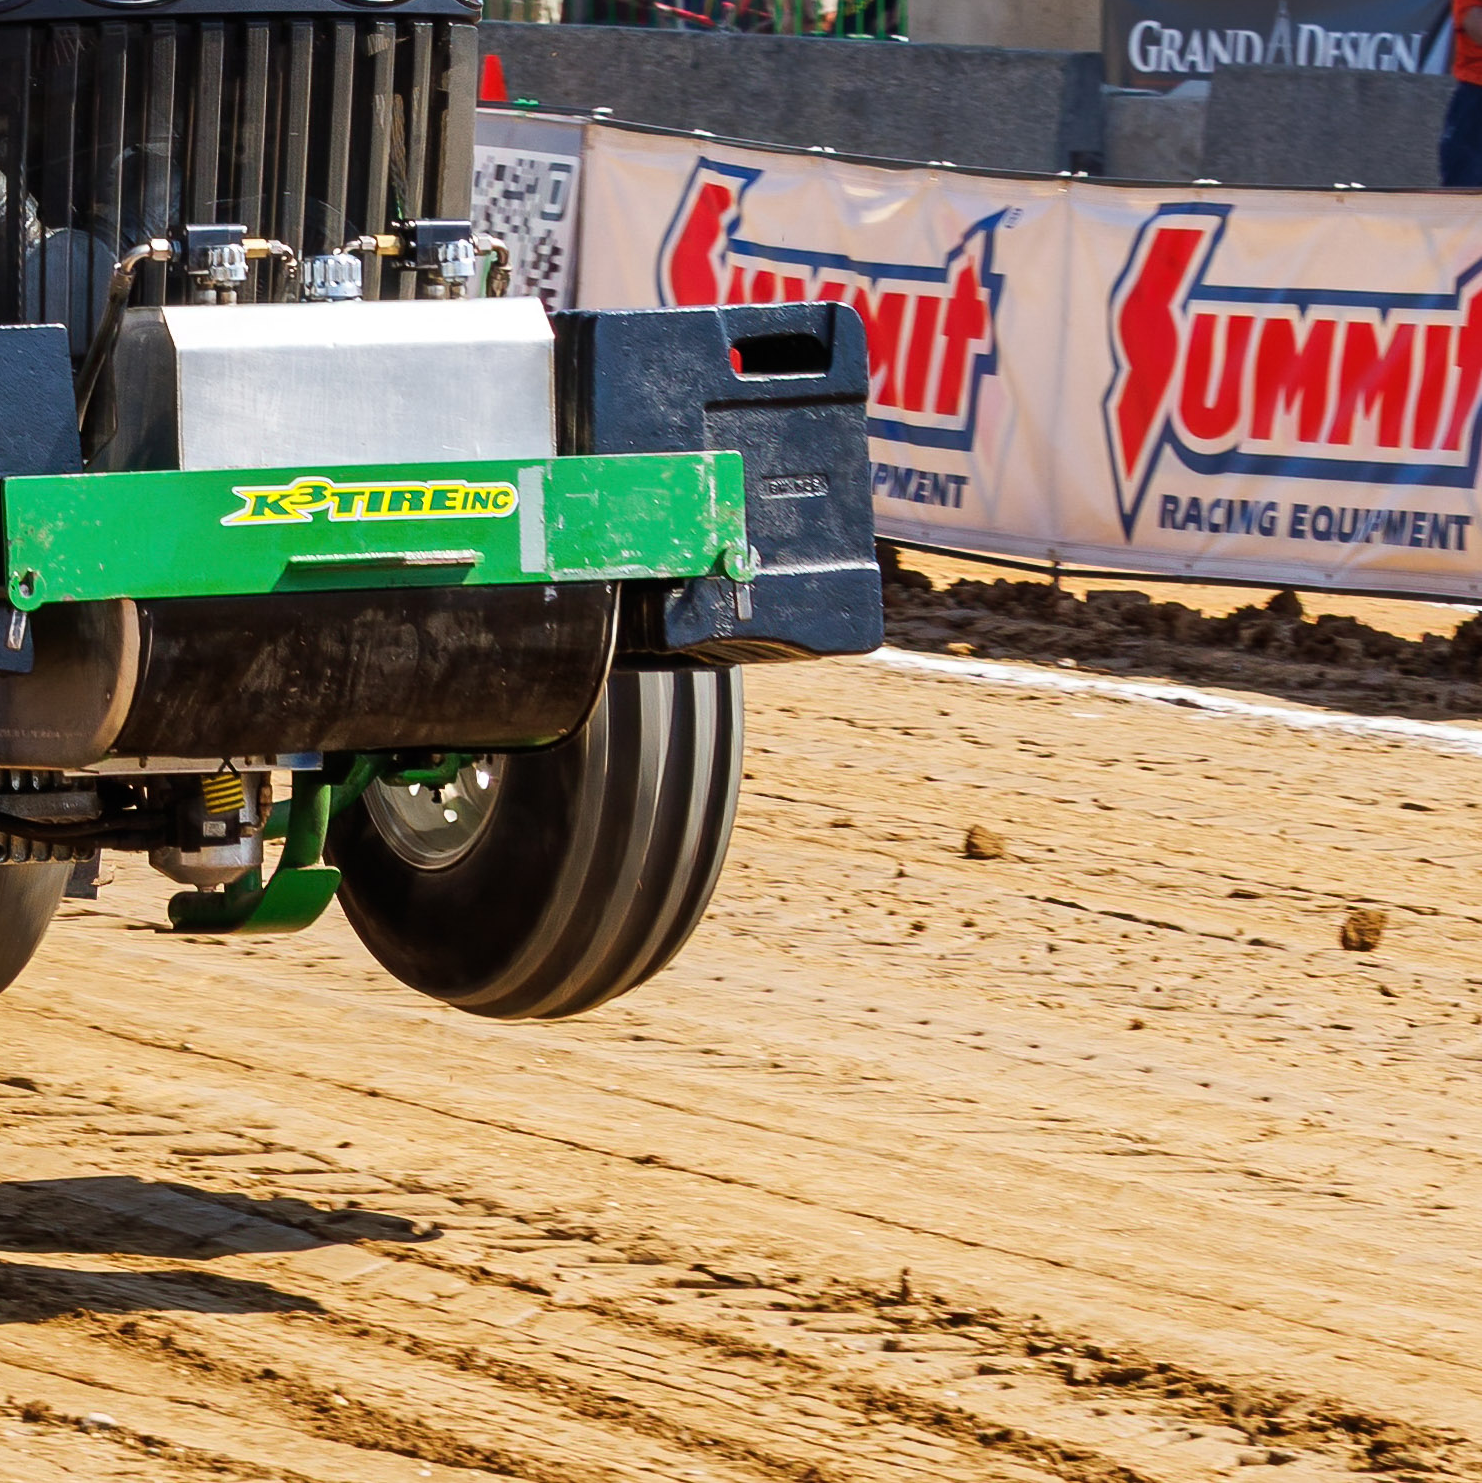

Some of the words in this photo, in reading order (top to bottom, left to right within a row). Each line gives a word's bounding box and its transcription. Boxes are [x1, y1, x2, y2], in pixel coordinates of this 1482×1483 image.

[1128, 20, 1264, 73] GRAND
[1297, 23, 1425, 74] DESIGN
[670, 182, 987, 416] SMIT
[872, 463, 971, 509] PMENT
[1158, 493, 1281, 537] RACING
[1289, 502, 1474, 552] EQUIPMENT
